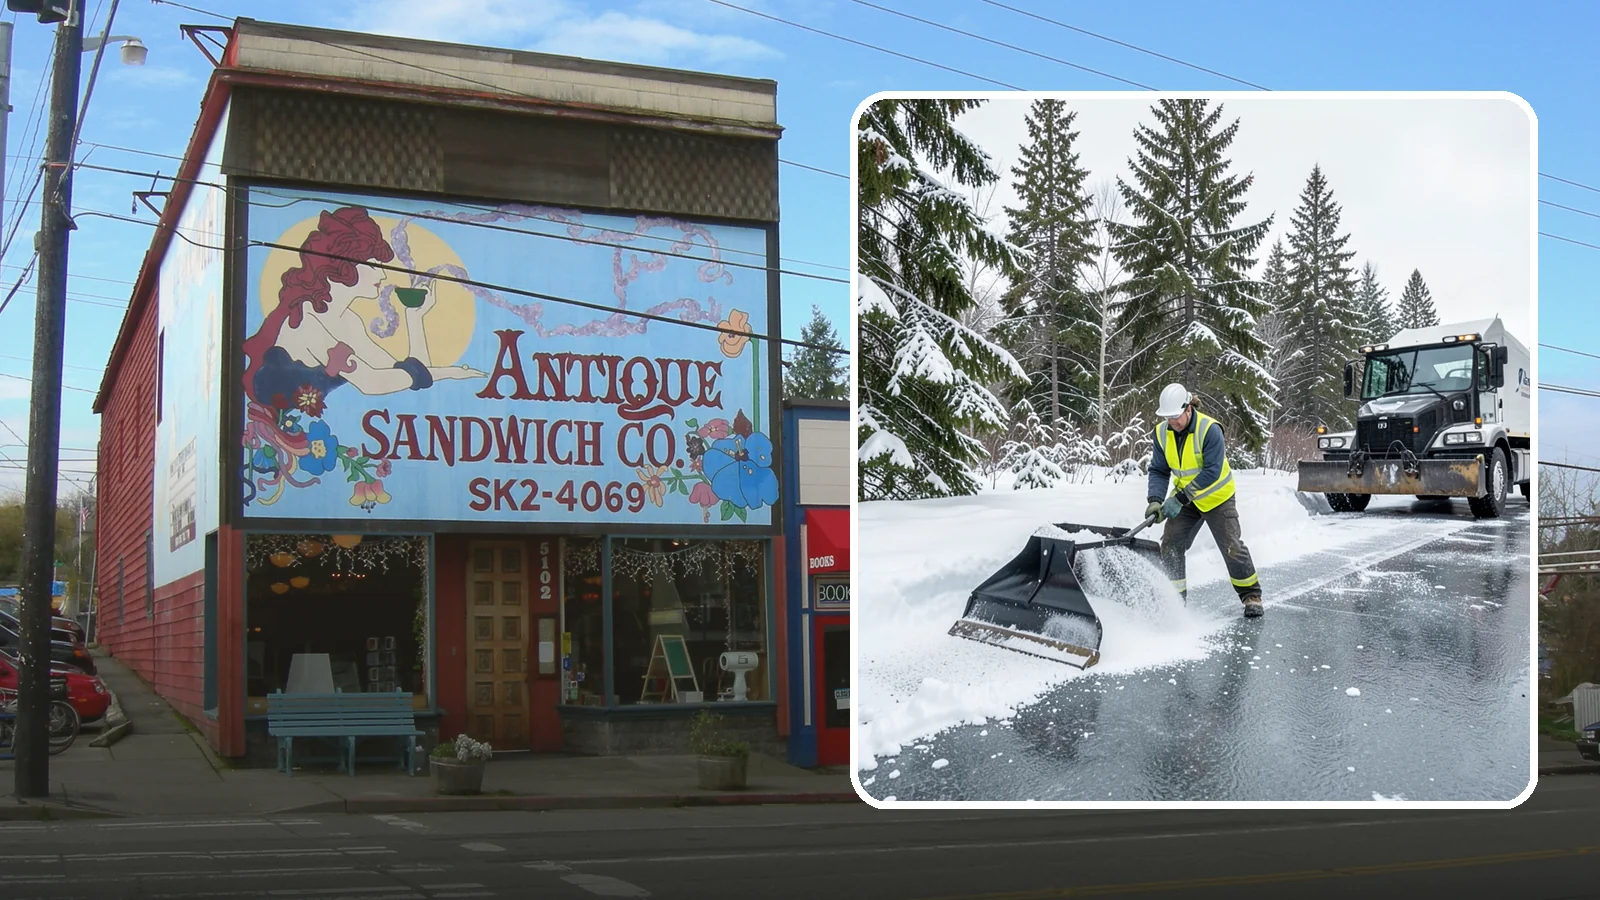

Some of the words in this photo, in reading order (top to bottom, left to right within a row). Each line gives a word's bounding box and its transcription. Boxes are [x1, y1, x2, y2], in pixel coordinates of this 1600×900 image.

[476, 329, 724, 421] ANTIQUE
[362, 409, 605, 467] SANDWICH
[617, 422, 686, 469] CO.
[469, 477, 646, 514] SK2-4069
[540, 541, 551, 600] 5102
[809, 555, 835, 569] BOOKS
